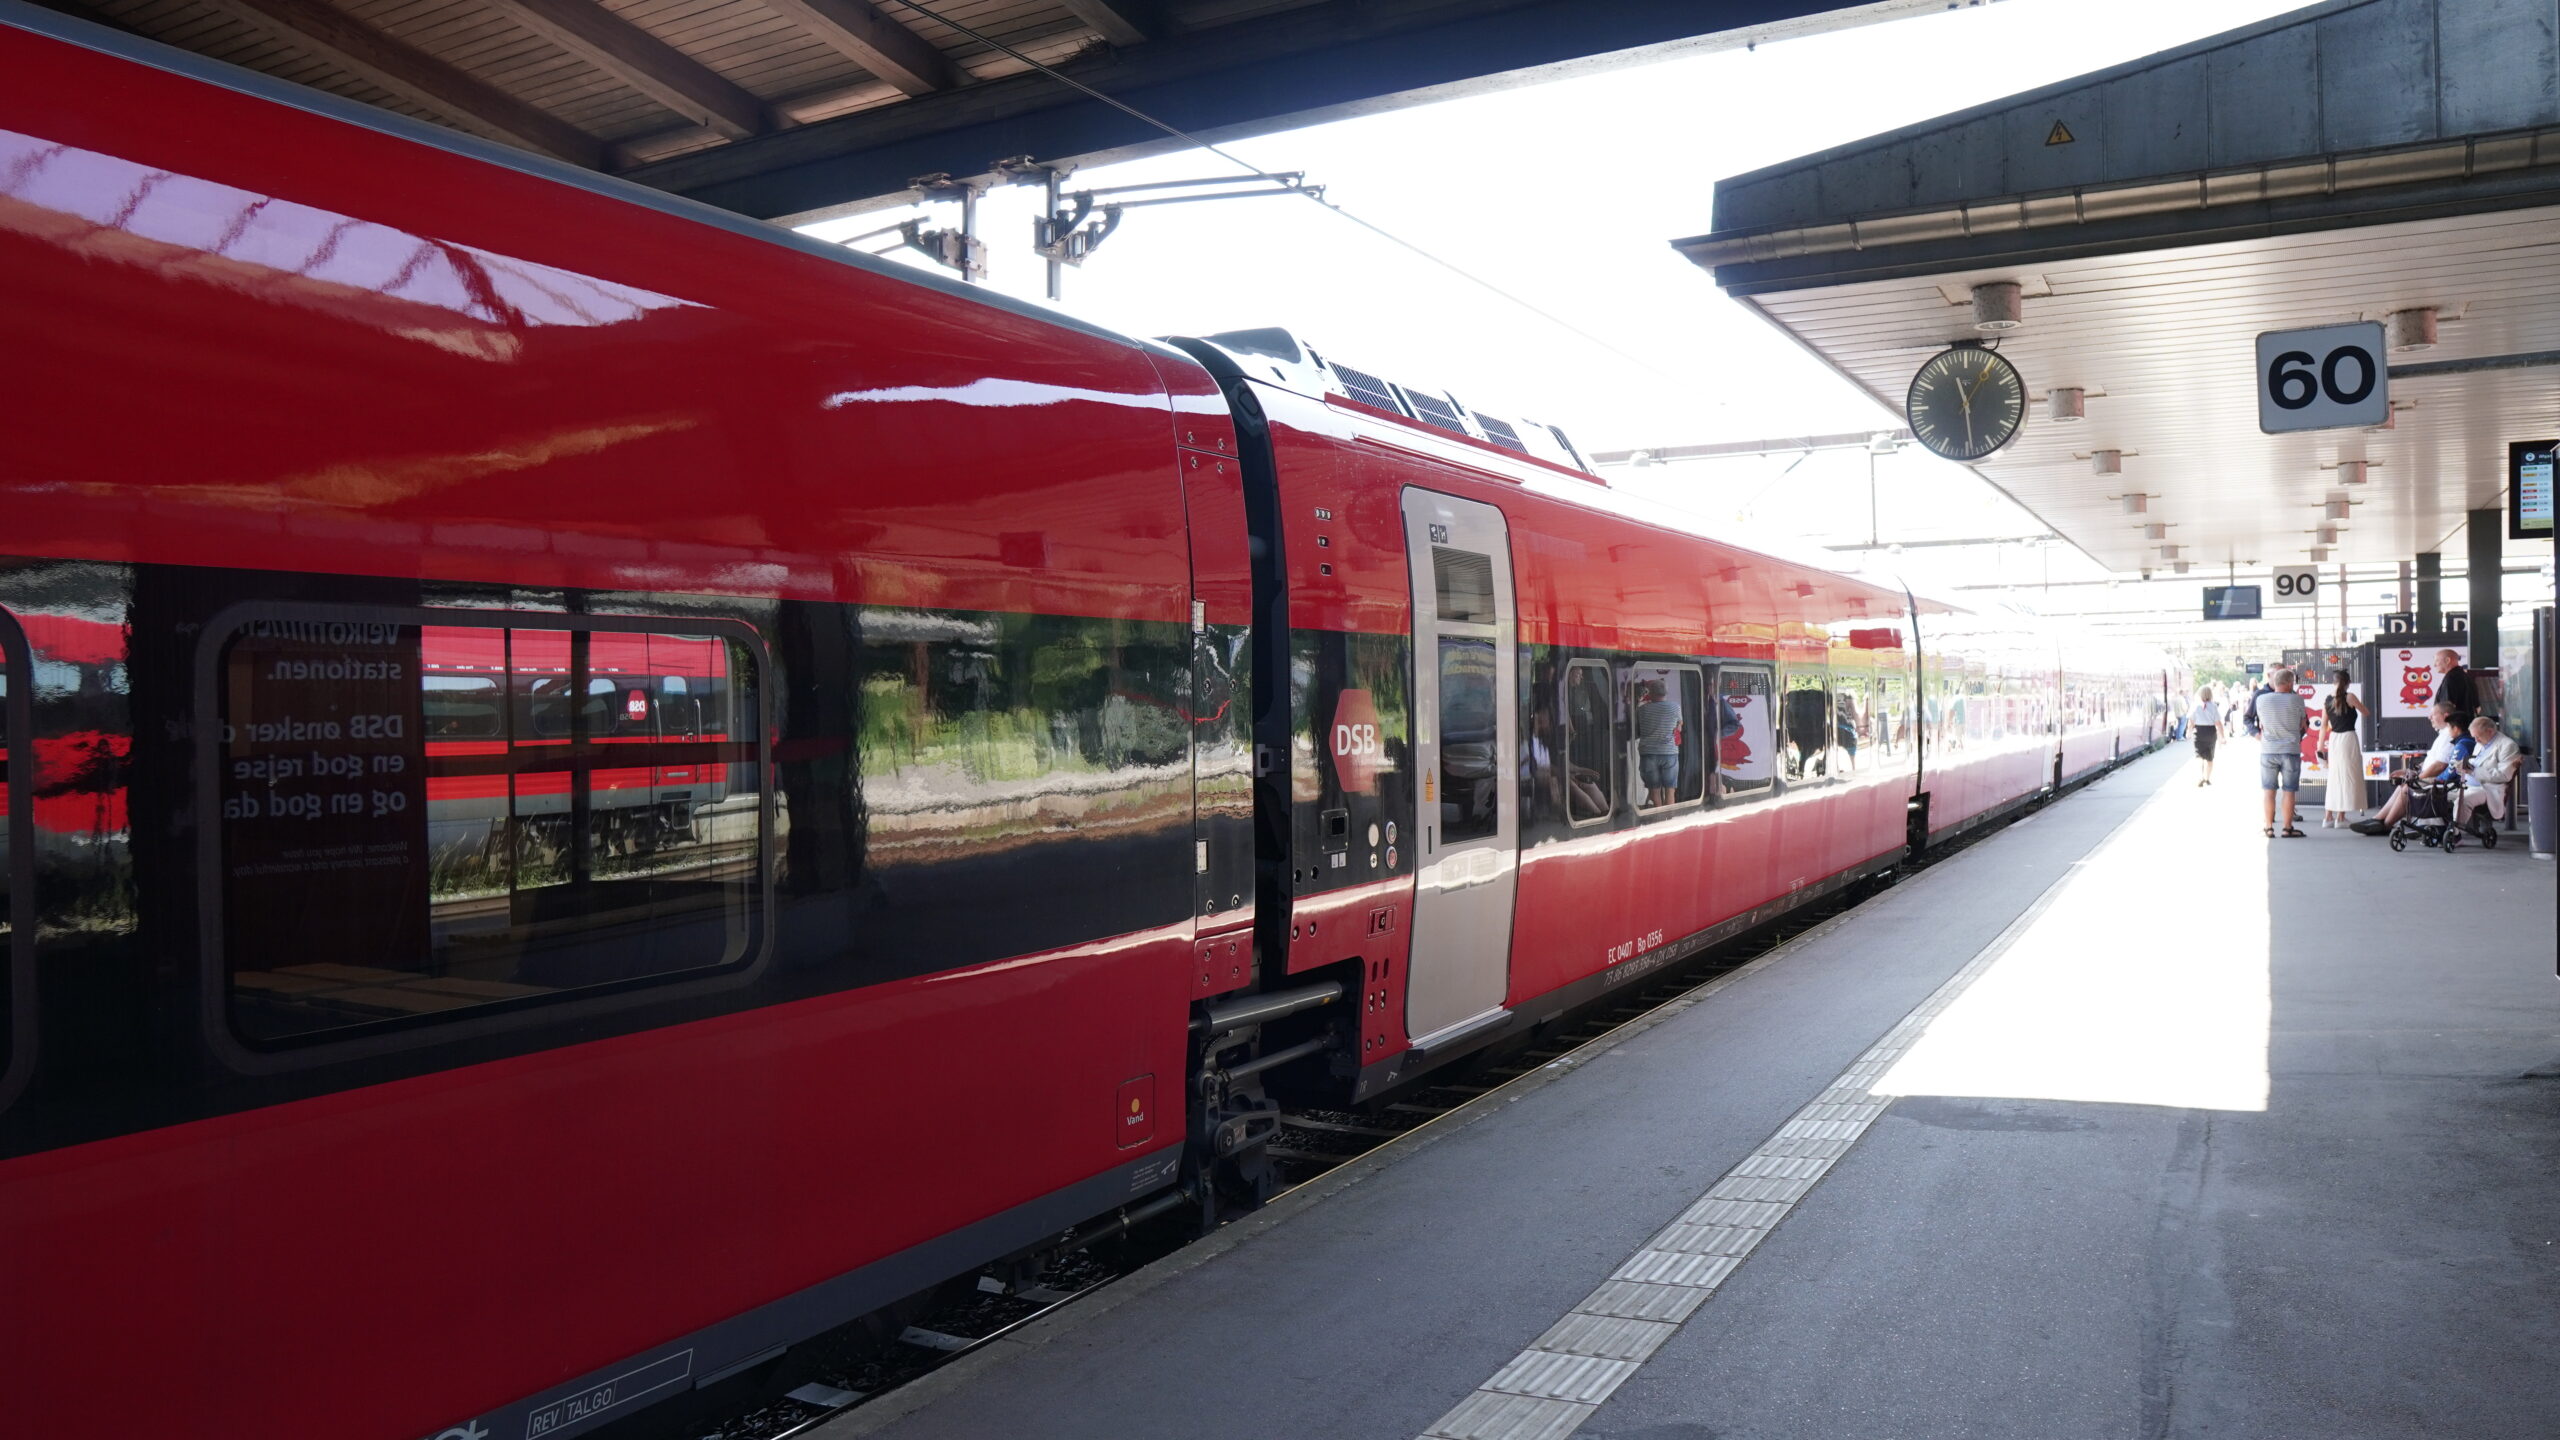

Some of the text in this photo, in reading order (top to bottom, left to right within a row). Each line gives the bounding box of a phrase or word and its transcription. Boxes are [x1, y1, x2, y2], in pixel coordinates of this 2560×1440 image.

[2267, 344, 2377, 410] 60
[2276, 573, 2316, 596] 90
[2390, 618, 2407, 633] D
[2453, 617, 2468, 632] D
[1336, 724, 1376, 757] DSB
[1608, 947, 1617, 964] EC
[1617, 941, 1633, 961] 0407
[1637, 937, 1646, 955] Bp
[1646, 928, 1663, 948] 0356
[1126, 1112, 1144, 1126] Vand
[567, 1387, 612, 1421] TALGO
[532, 1408, 560, 1435] REV
